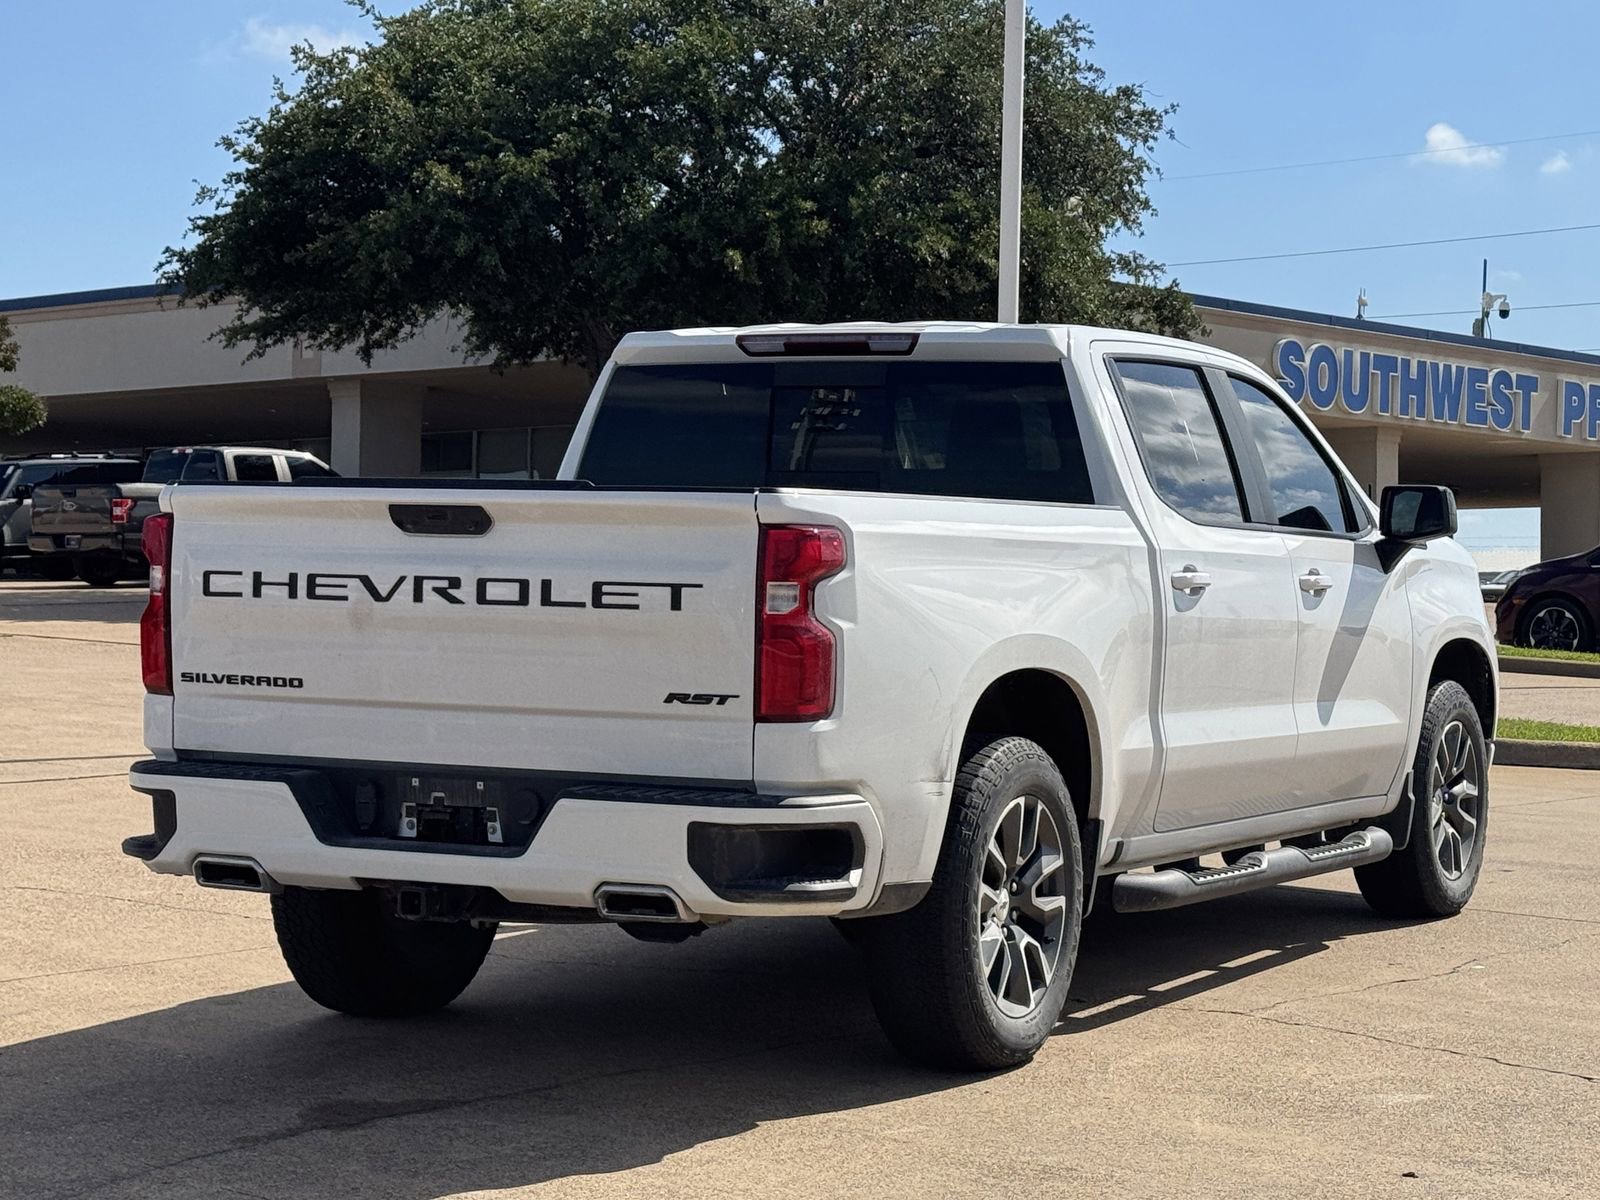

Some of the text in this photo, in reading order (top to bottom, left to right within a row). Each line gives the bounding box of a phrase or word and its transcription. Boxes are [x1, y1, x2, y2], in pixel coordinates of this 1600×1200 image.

[1274, 339, 1540, 433] SOUTHWEST
[203, 570, 704, 612] CHEVROLET
[181, 672, 304, 689] SILVERADO
[662, 692, 741, 706] RST
